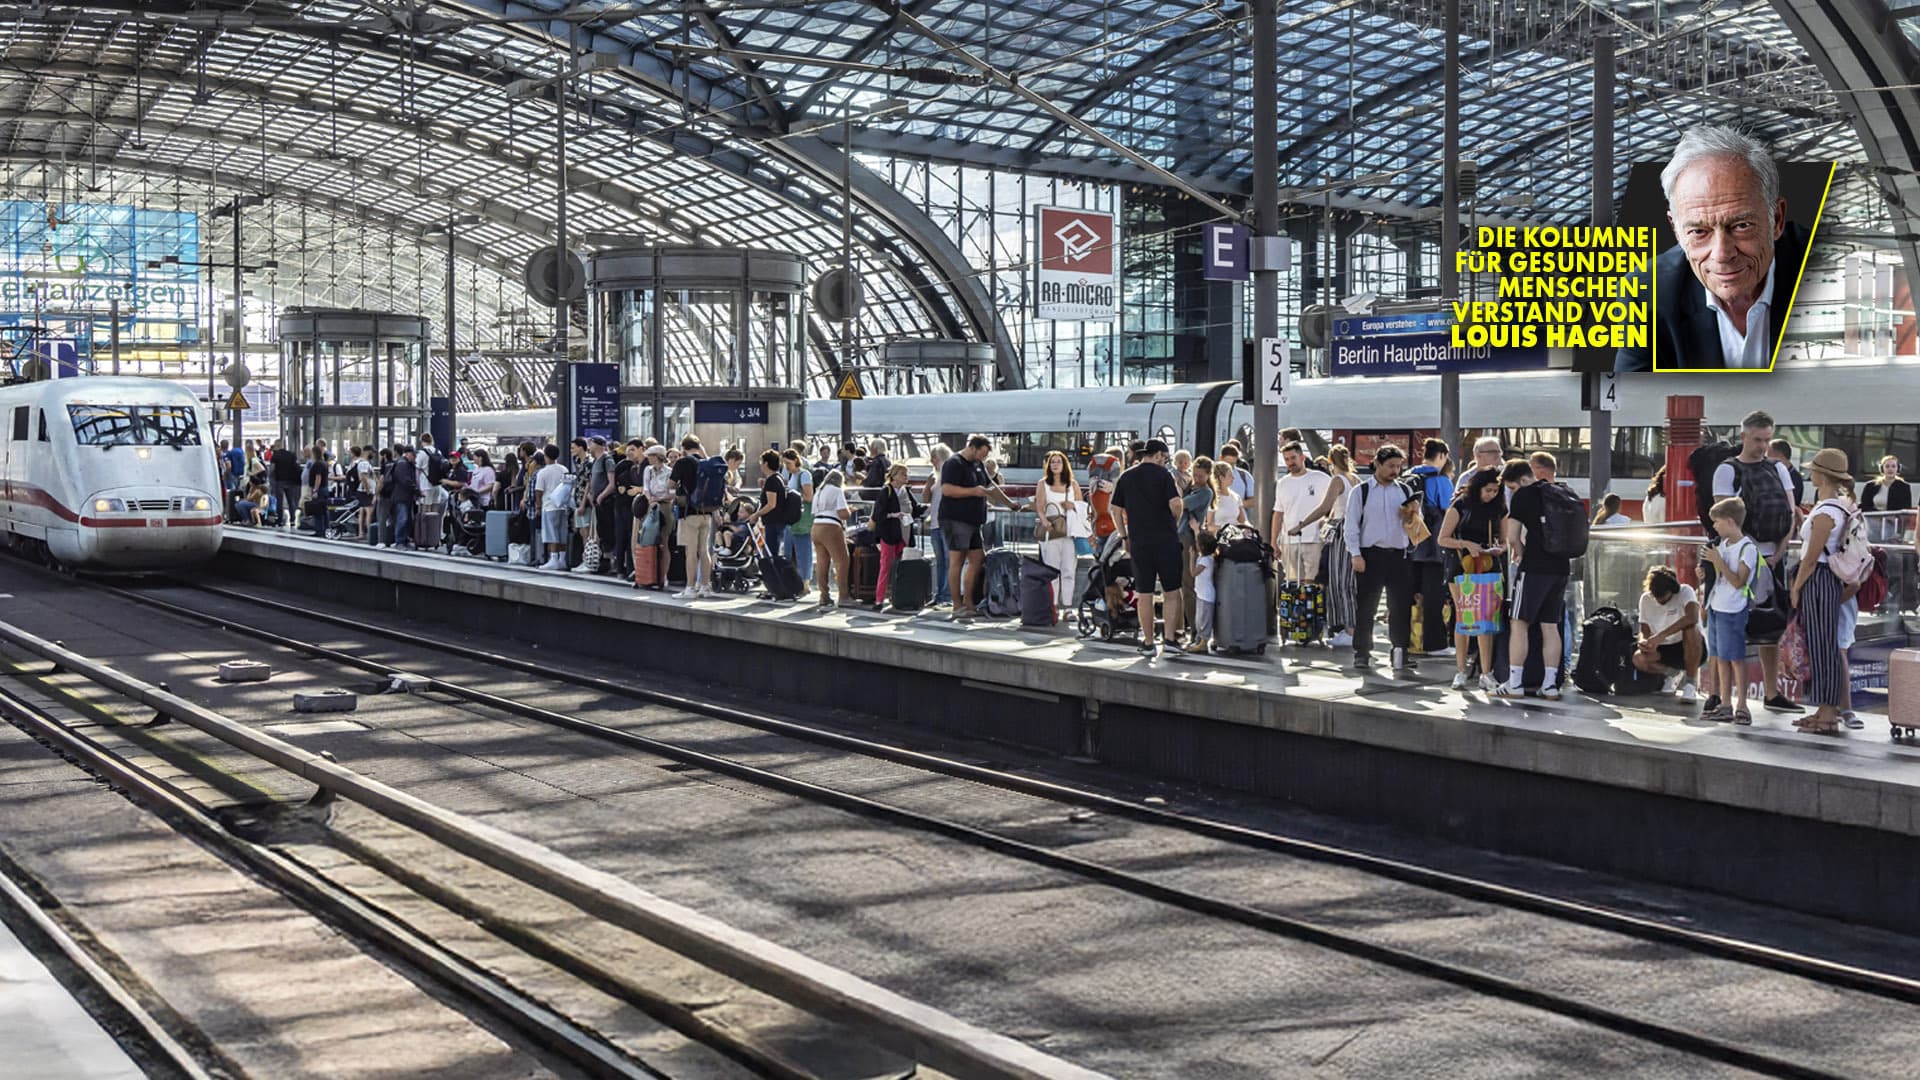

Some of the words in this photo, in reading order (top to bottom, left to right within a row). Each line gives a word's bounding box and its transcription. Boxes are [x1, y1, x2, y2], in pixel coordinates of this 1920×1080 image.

[1213, 226, 1234, 268] E
[1362, 321, 1384, 331] Europa
[1386, 319, 1417, 329] verstehen
[1270, 343, 1282, 367] 5
[1338, 345, 1380, 365] Berlin
[1270, 371, 1283, 395] 4
[1606, 383, 1616, 403] 4
